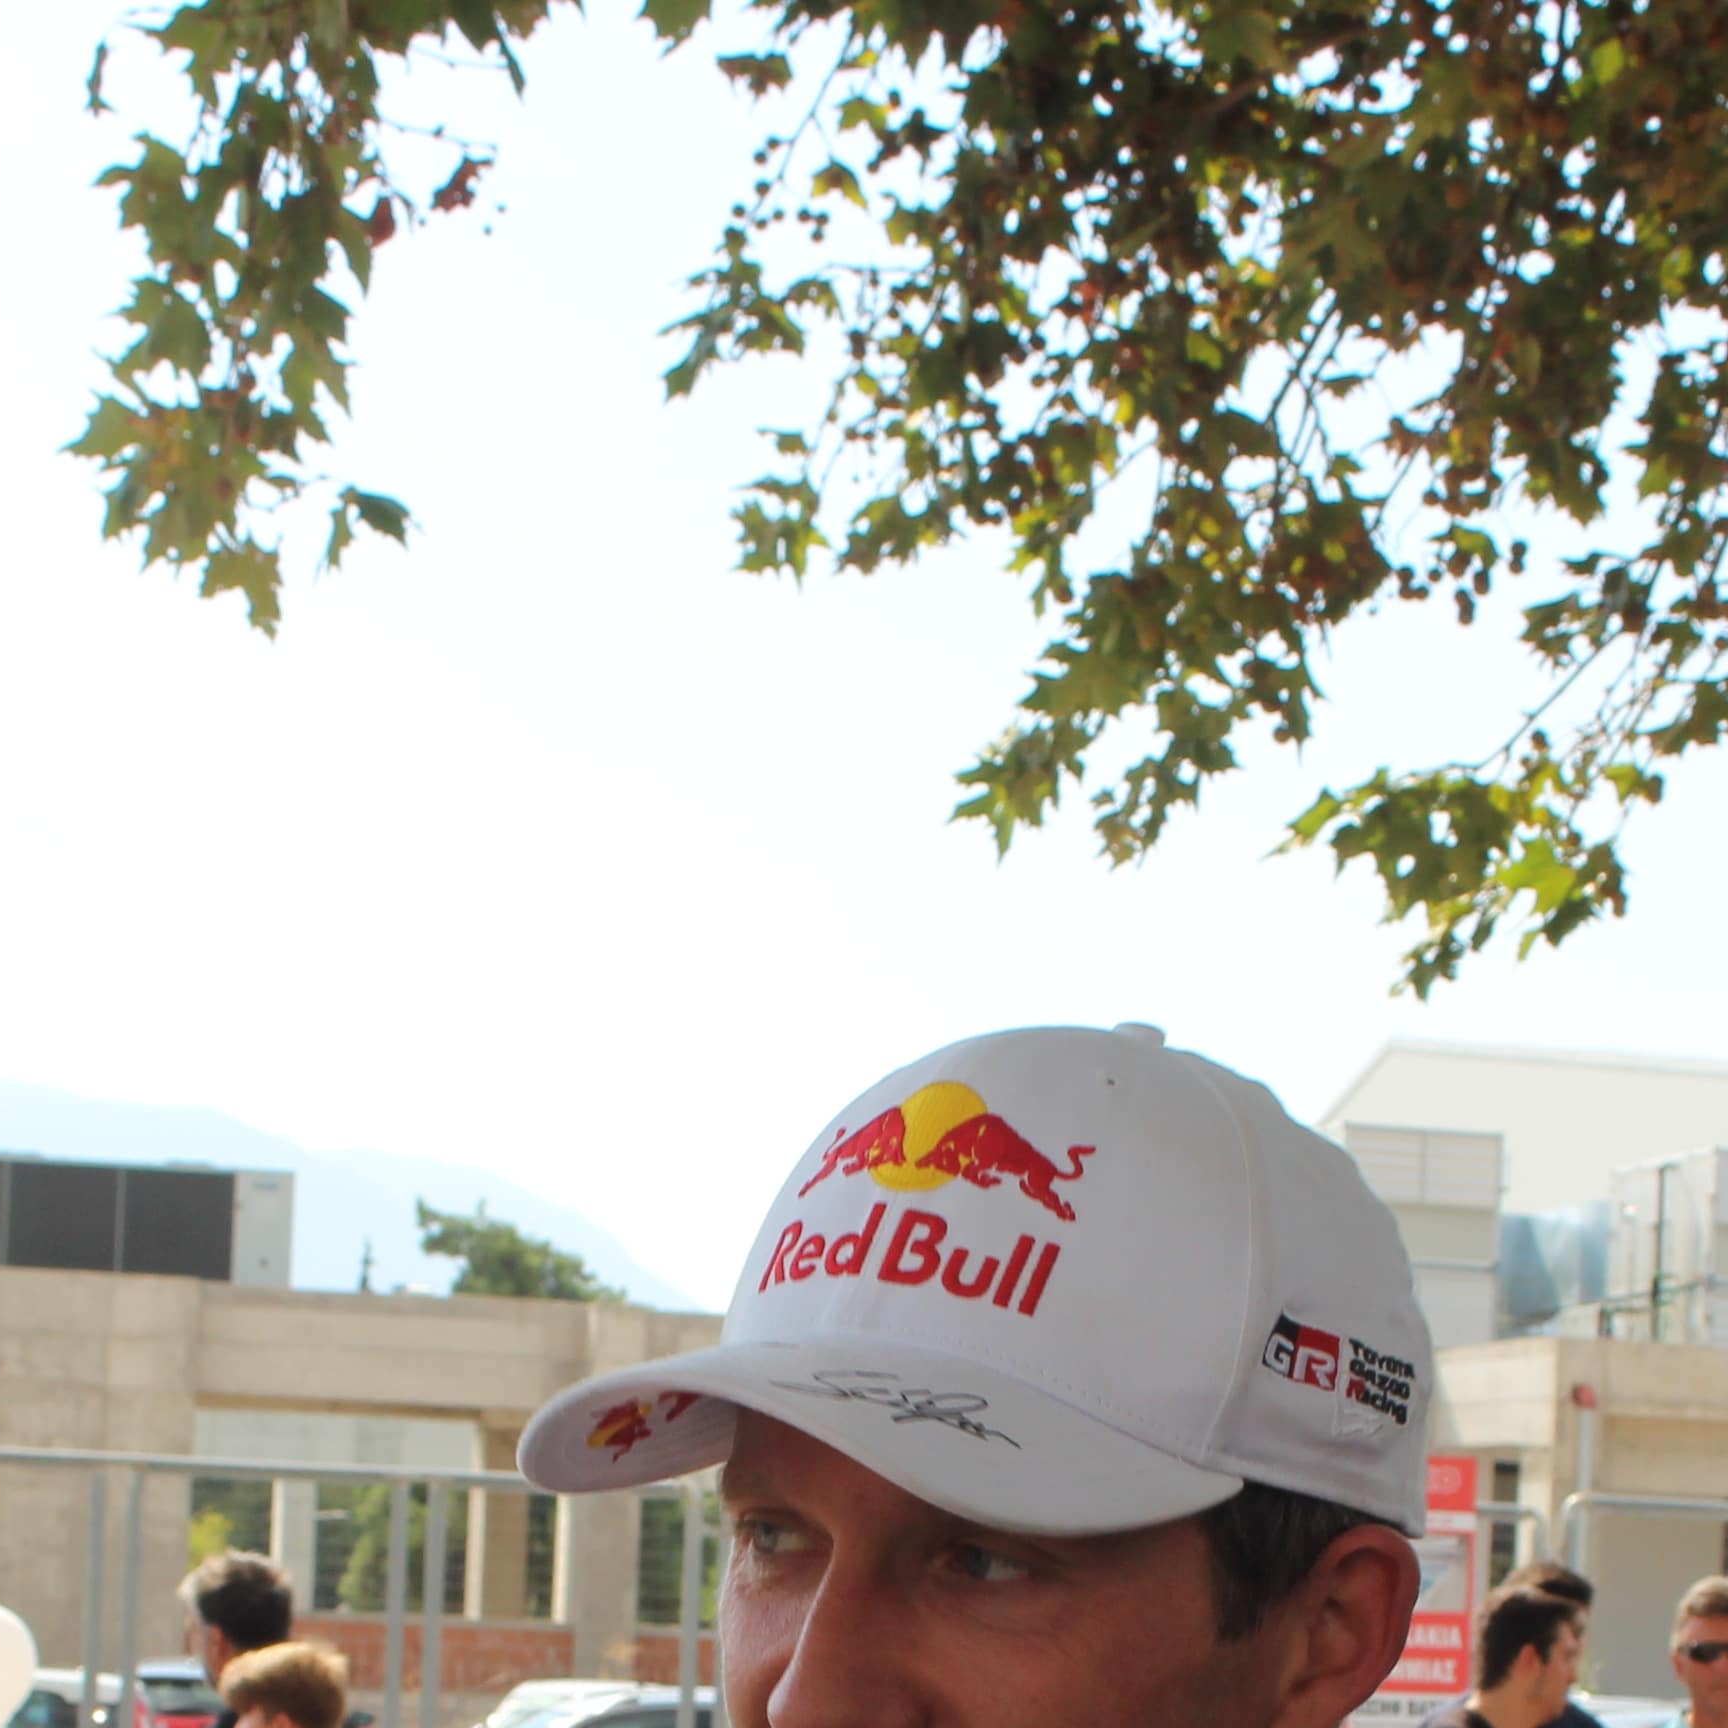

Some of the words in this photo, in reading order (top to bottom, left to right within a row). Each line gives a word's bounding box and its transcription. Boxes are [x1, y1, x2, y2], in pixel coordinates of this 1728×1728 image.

[759, 1202, 887, 1294] Red
[877, 1209, 1061, 1318] Bull
[1265, 1332, 1336, 1391] GR
[1348, 1338, 1415, 1379] TOYOTA
[1345, 1378, 1408, 1426] Racing
